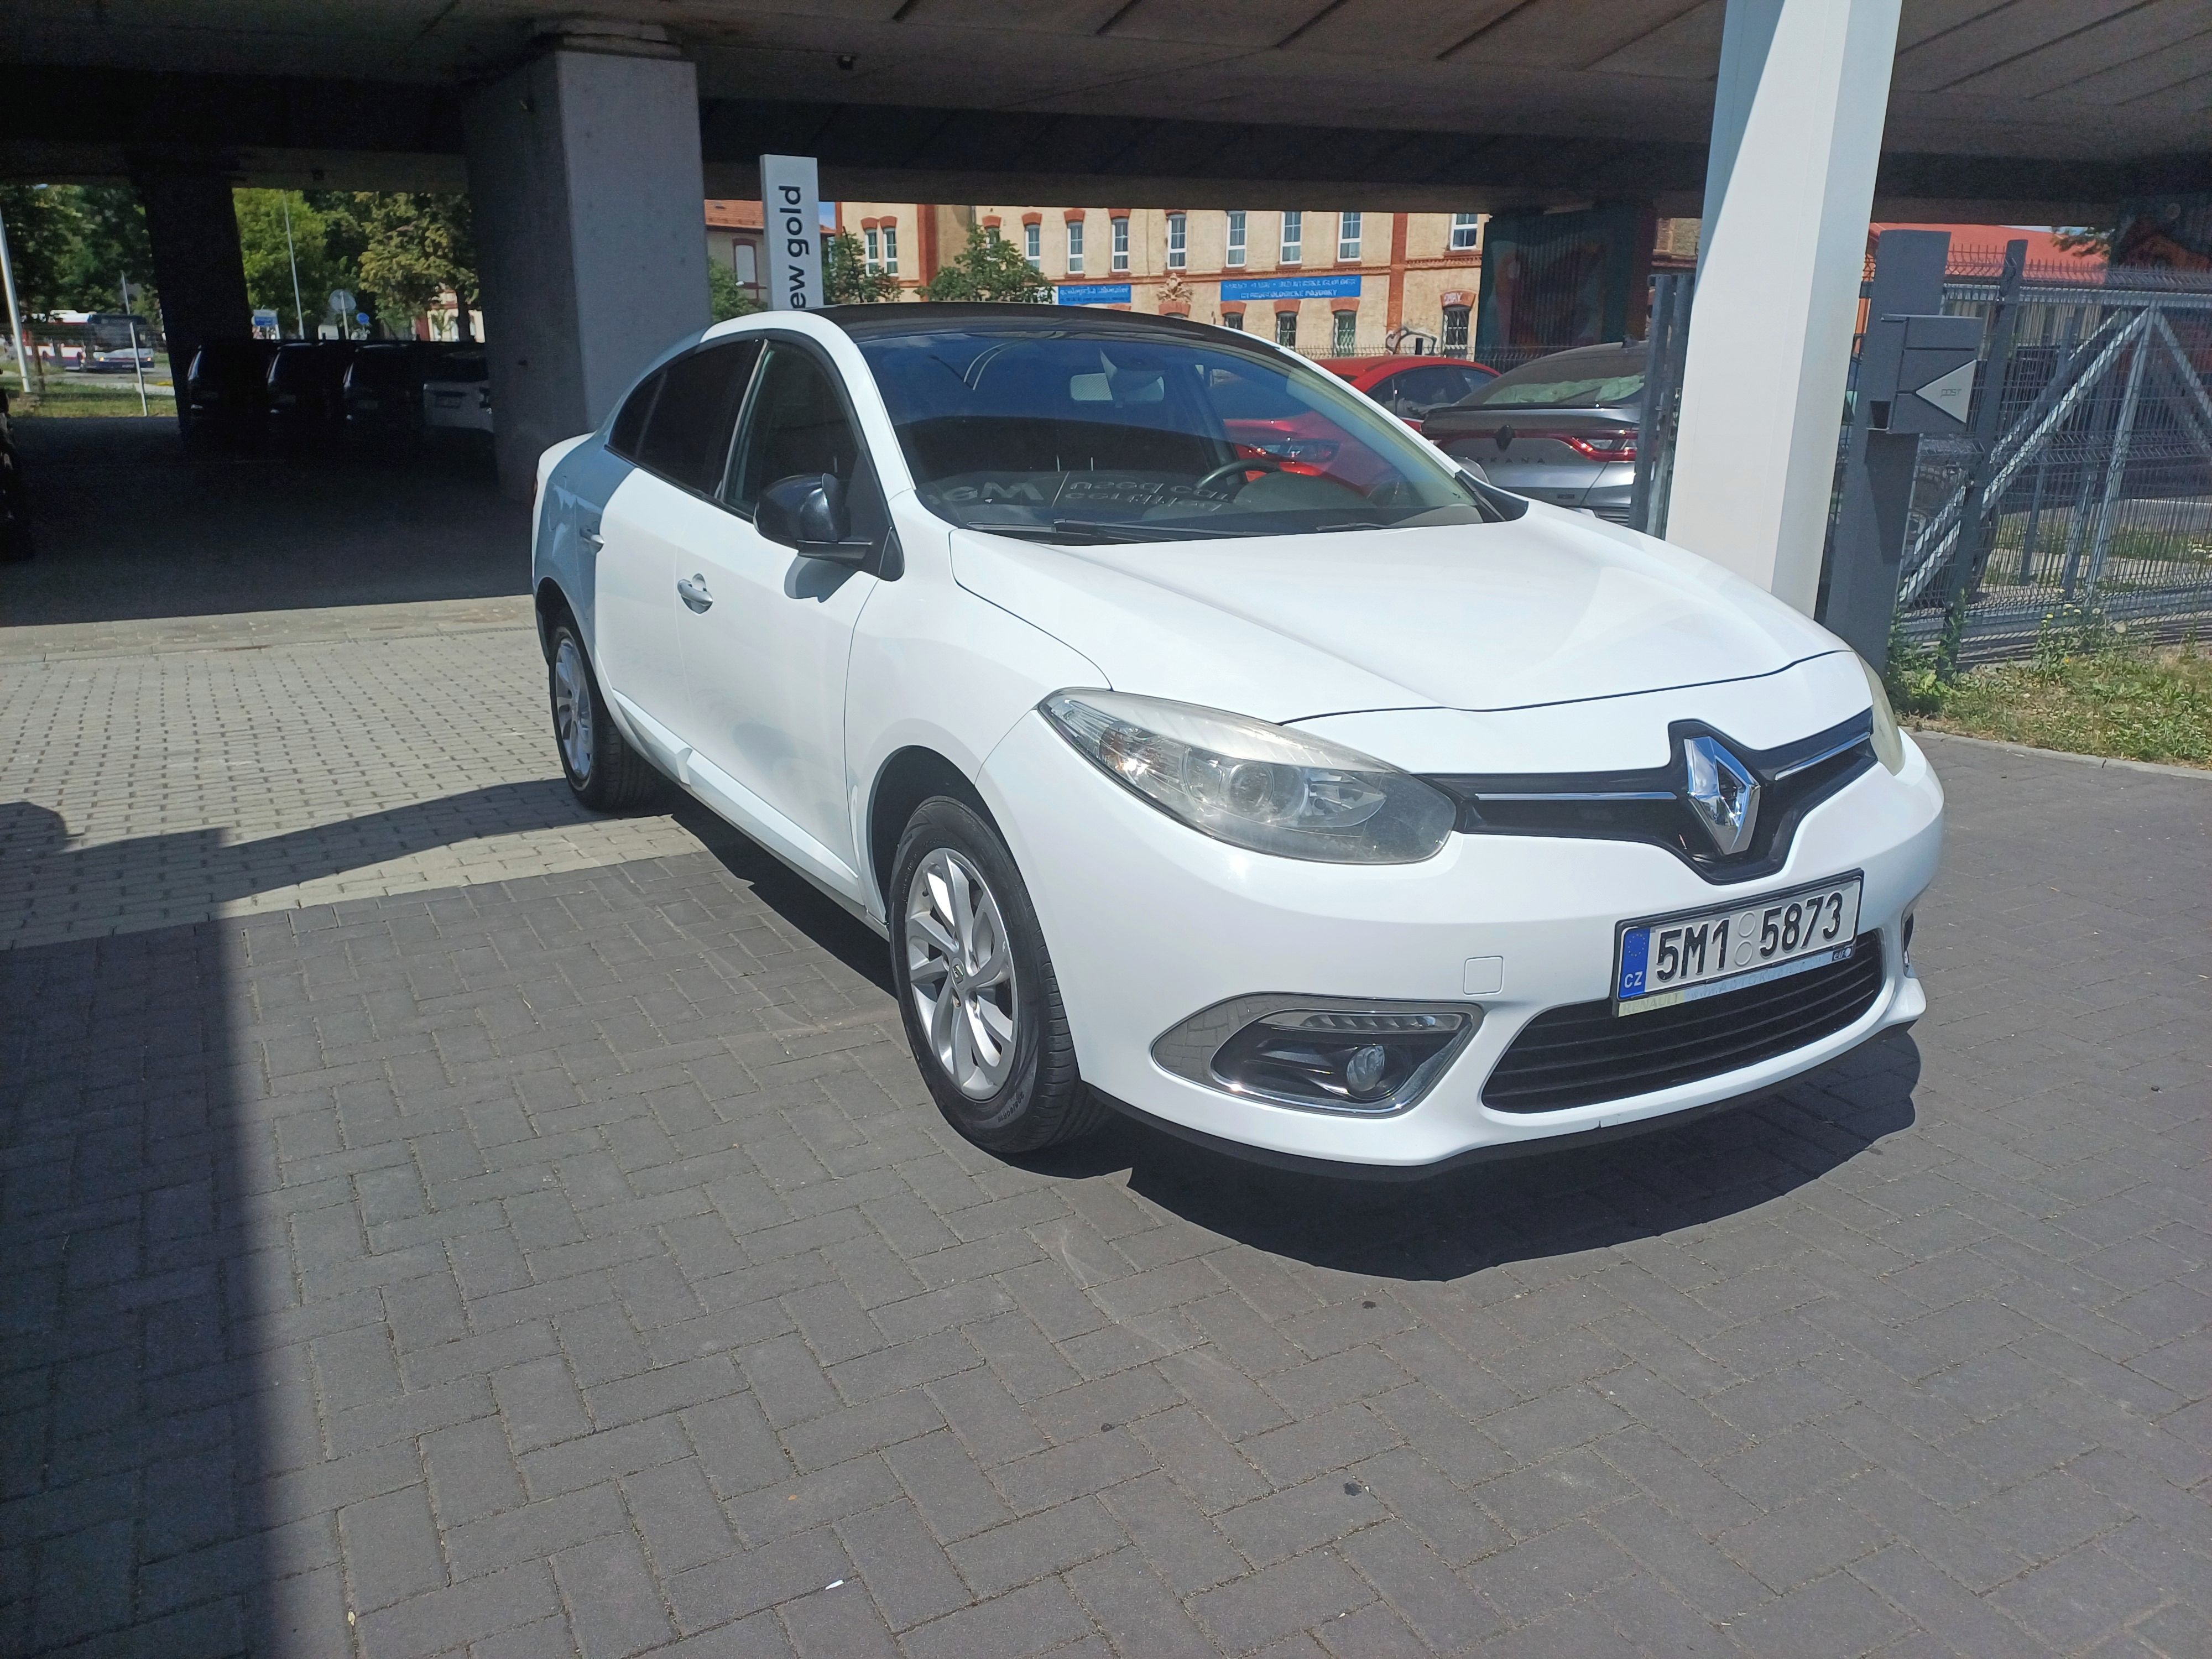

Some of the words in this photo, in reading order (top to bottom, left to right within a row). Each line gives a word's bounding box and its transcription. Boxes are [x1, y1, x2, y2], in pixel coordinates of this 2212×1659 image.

[779, 185, 810, 258] gold
[1657, 920, 1729, 981] 5M1
[1761, 893, 1843, 957] 5873
[1833, 950, 1846, 960] elf
[1624, 972, 1642, 989] CZ
